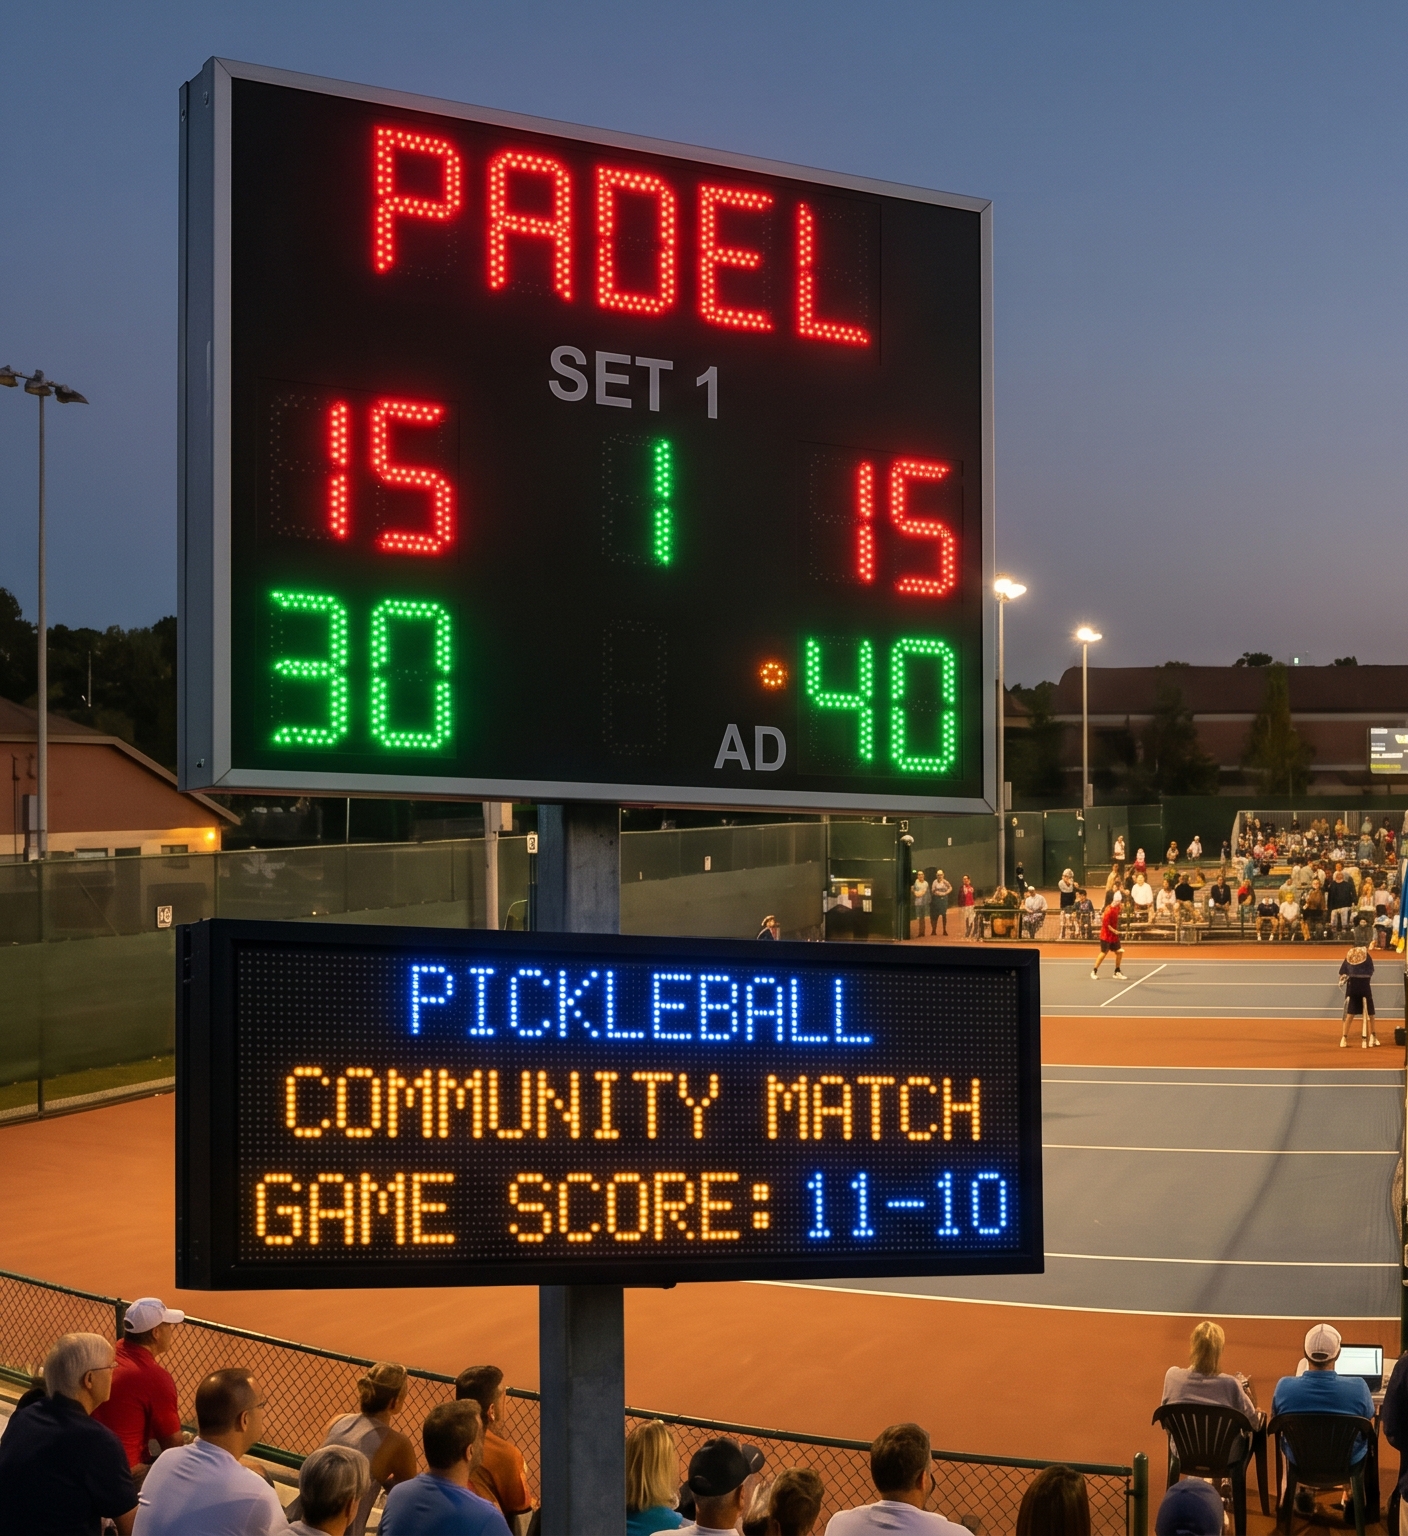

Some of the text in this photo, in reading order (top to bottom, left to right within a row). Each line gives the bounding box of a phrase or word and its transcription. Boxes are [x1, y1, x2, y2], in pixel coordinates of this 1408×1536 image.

[374, 126, 869, 346] PADEL
[549, 346, 717, 419] SET 1
[328, 398, 454, 555] 15
[654, 439, 672, 565] 1
[856, 458, 957, 597] 15
[271, 590, 452, 750] 30
[806, 638, 955, 773] 40
[714, 724, 786, 771] AD
[409, 964, 872, 1044] PICKLEBALL
[286, 1067, 980, 1140] COMMUNITY MATCH
[256, 1172, 1006, 1245] GAME SCORE: 11-10
